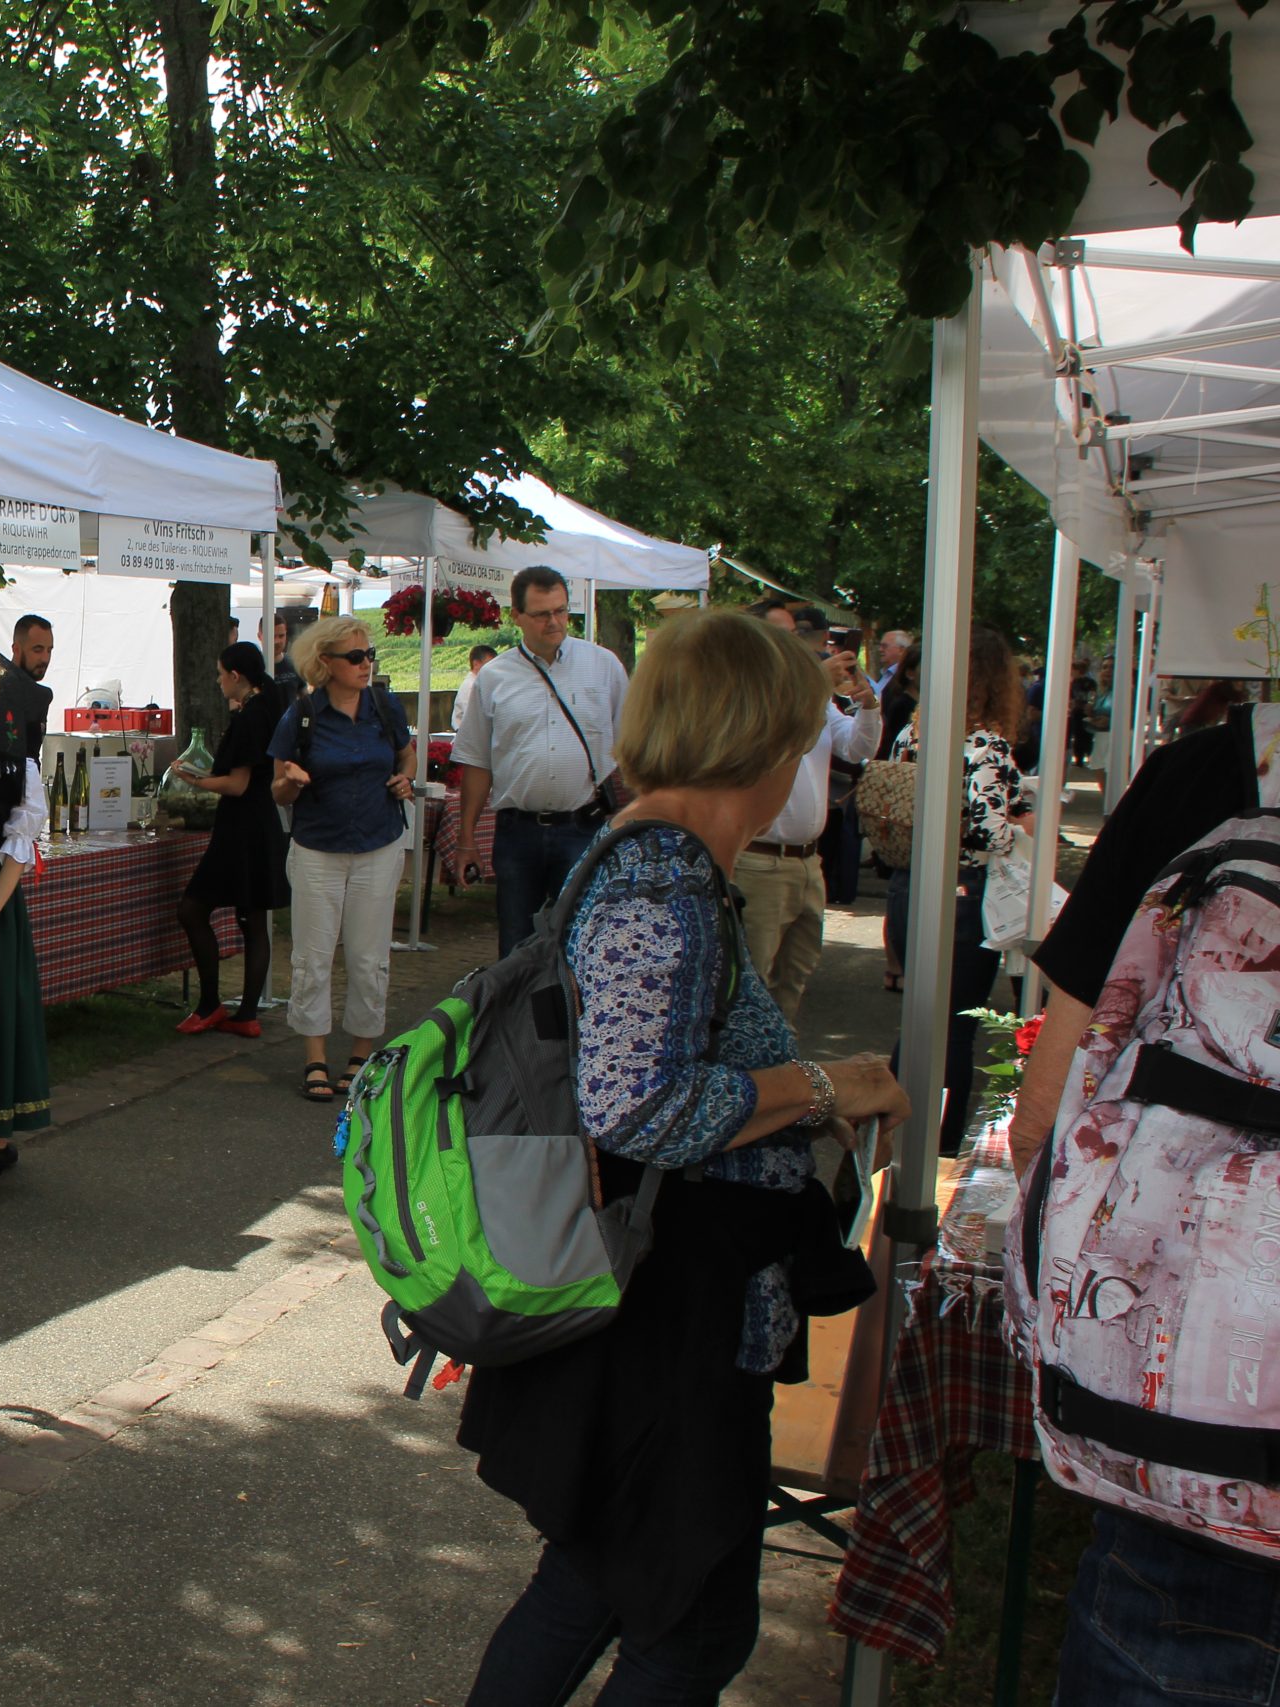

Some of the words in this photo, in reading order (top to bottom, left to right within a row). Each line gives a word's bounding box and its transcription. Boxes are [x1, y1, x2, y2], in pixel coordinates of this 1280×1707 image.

[39, 505, 66, 523] D'OR
[2, 522, 48, 539] RIQUEWIHR
[153, 521, 173, 538] Vins
[176, 522, 206, 540] Fritsch
[128, 538, 133, 551] 2,
[135, 541, 145, 552] rue
[148, 540, 159, 553] des
[161, 541, 186, 555] Tuileries
[192, 544, 227, 558] RIQUEWIHR
[121, 554, 130, 567] 03
[132, 555, 142, 568] 89
[143, 556, 152, 569] 49
[154, 558, 163, 569] 01
[165, 559, 174, 571] 98
[180, 562, 232, 575] vins.fritsch.free.fr
[417, 1201, 428, 1214] 18
